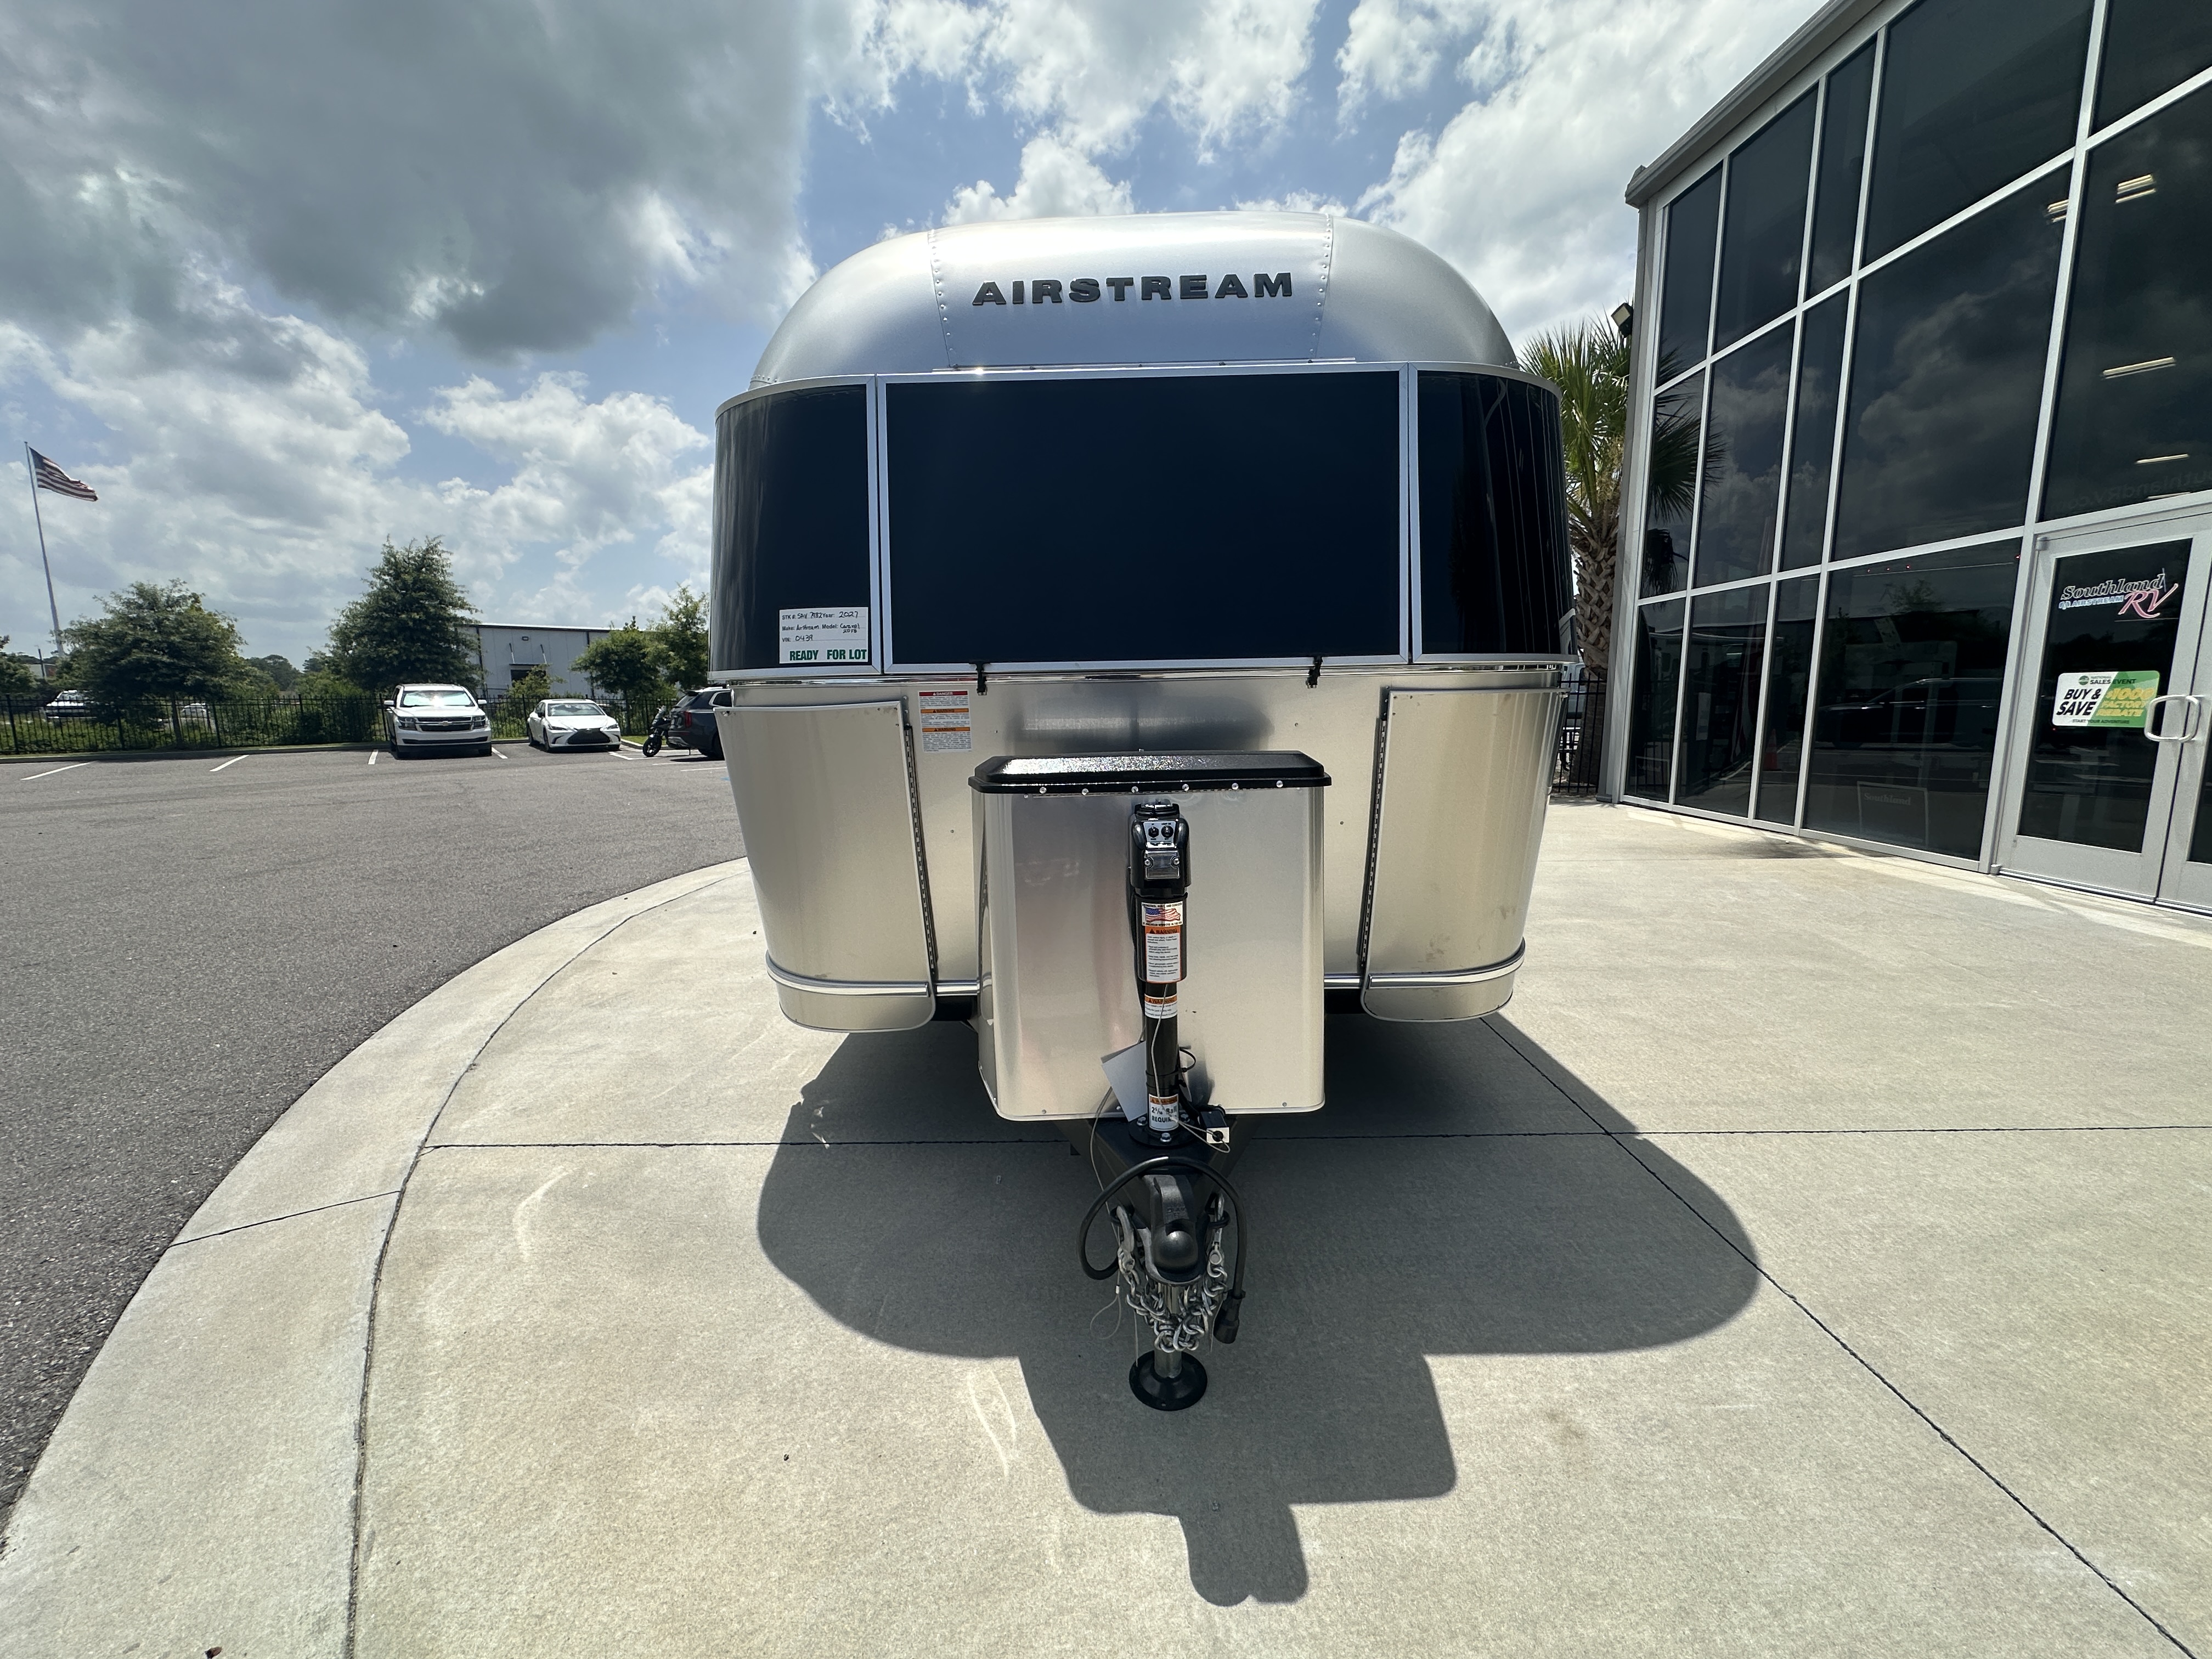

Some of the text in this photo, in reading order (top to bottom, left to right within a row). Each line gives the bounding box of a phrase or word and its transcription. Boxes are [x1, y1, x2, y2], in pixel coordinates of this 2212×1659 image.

[972, 272, 1293, 306] AIRSTREAM
[2061, 573, 2165, 600] Southland
[2071, 595, 2124, 607] AIRSTREAM
[2118, 583, 2178, 618] RV
[789, 649, 867, 661] READY FOR LOT
[2064, 689, 2102, 699] BUY &
[2056, 701, 2097, 715] SAVE
[1864, 793, 1911, 805] Southland
